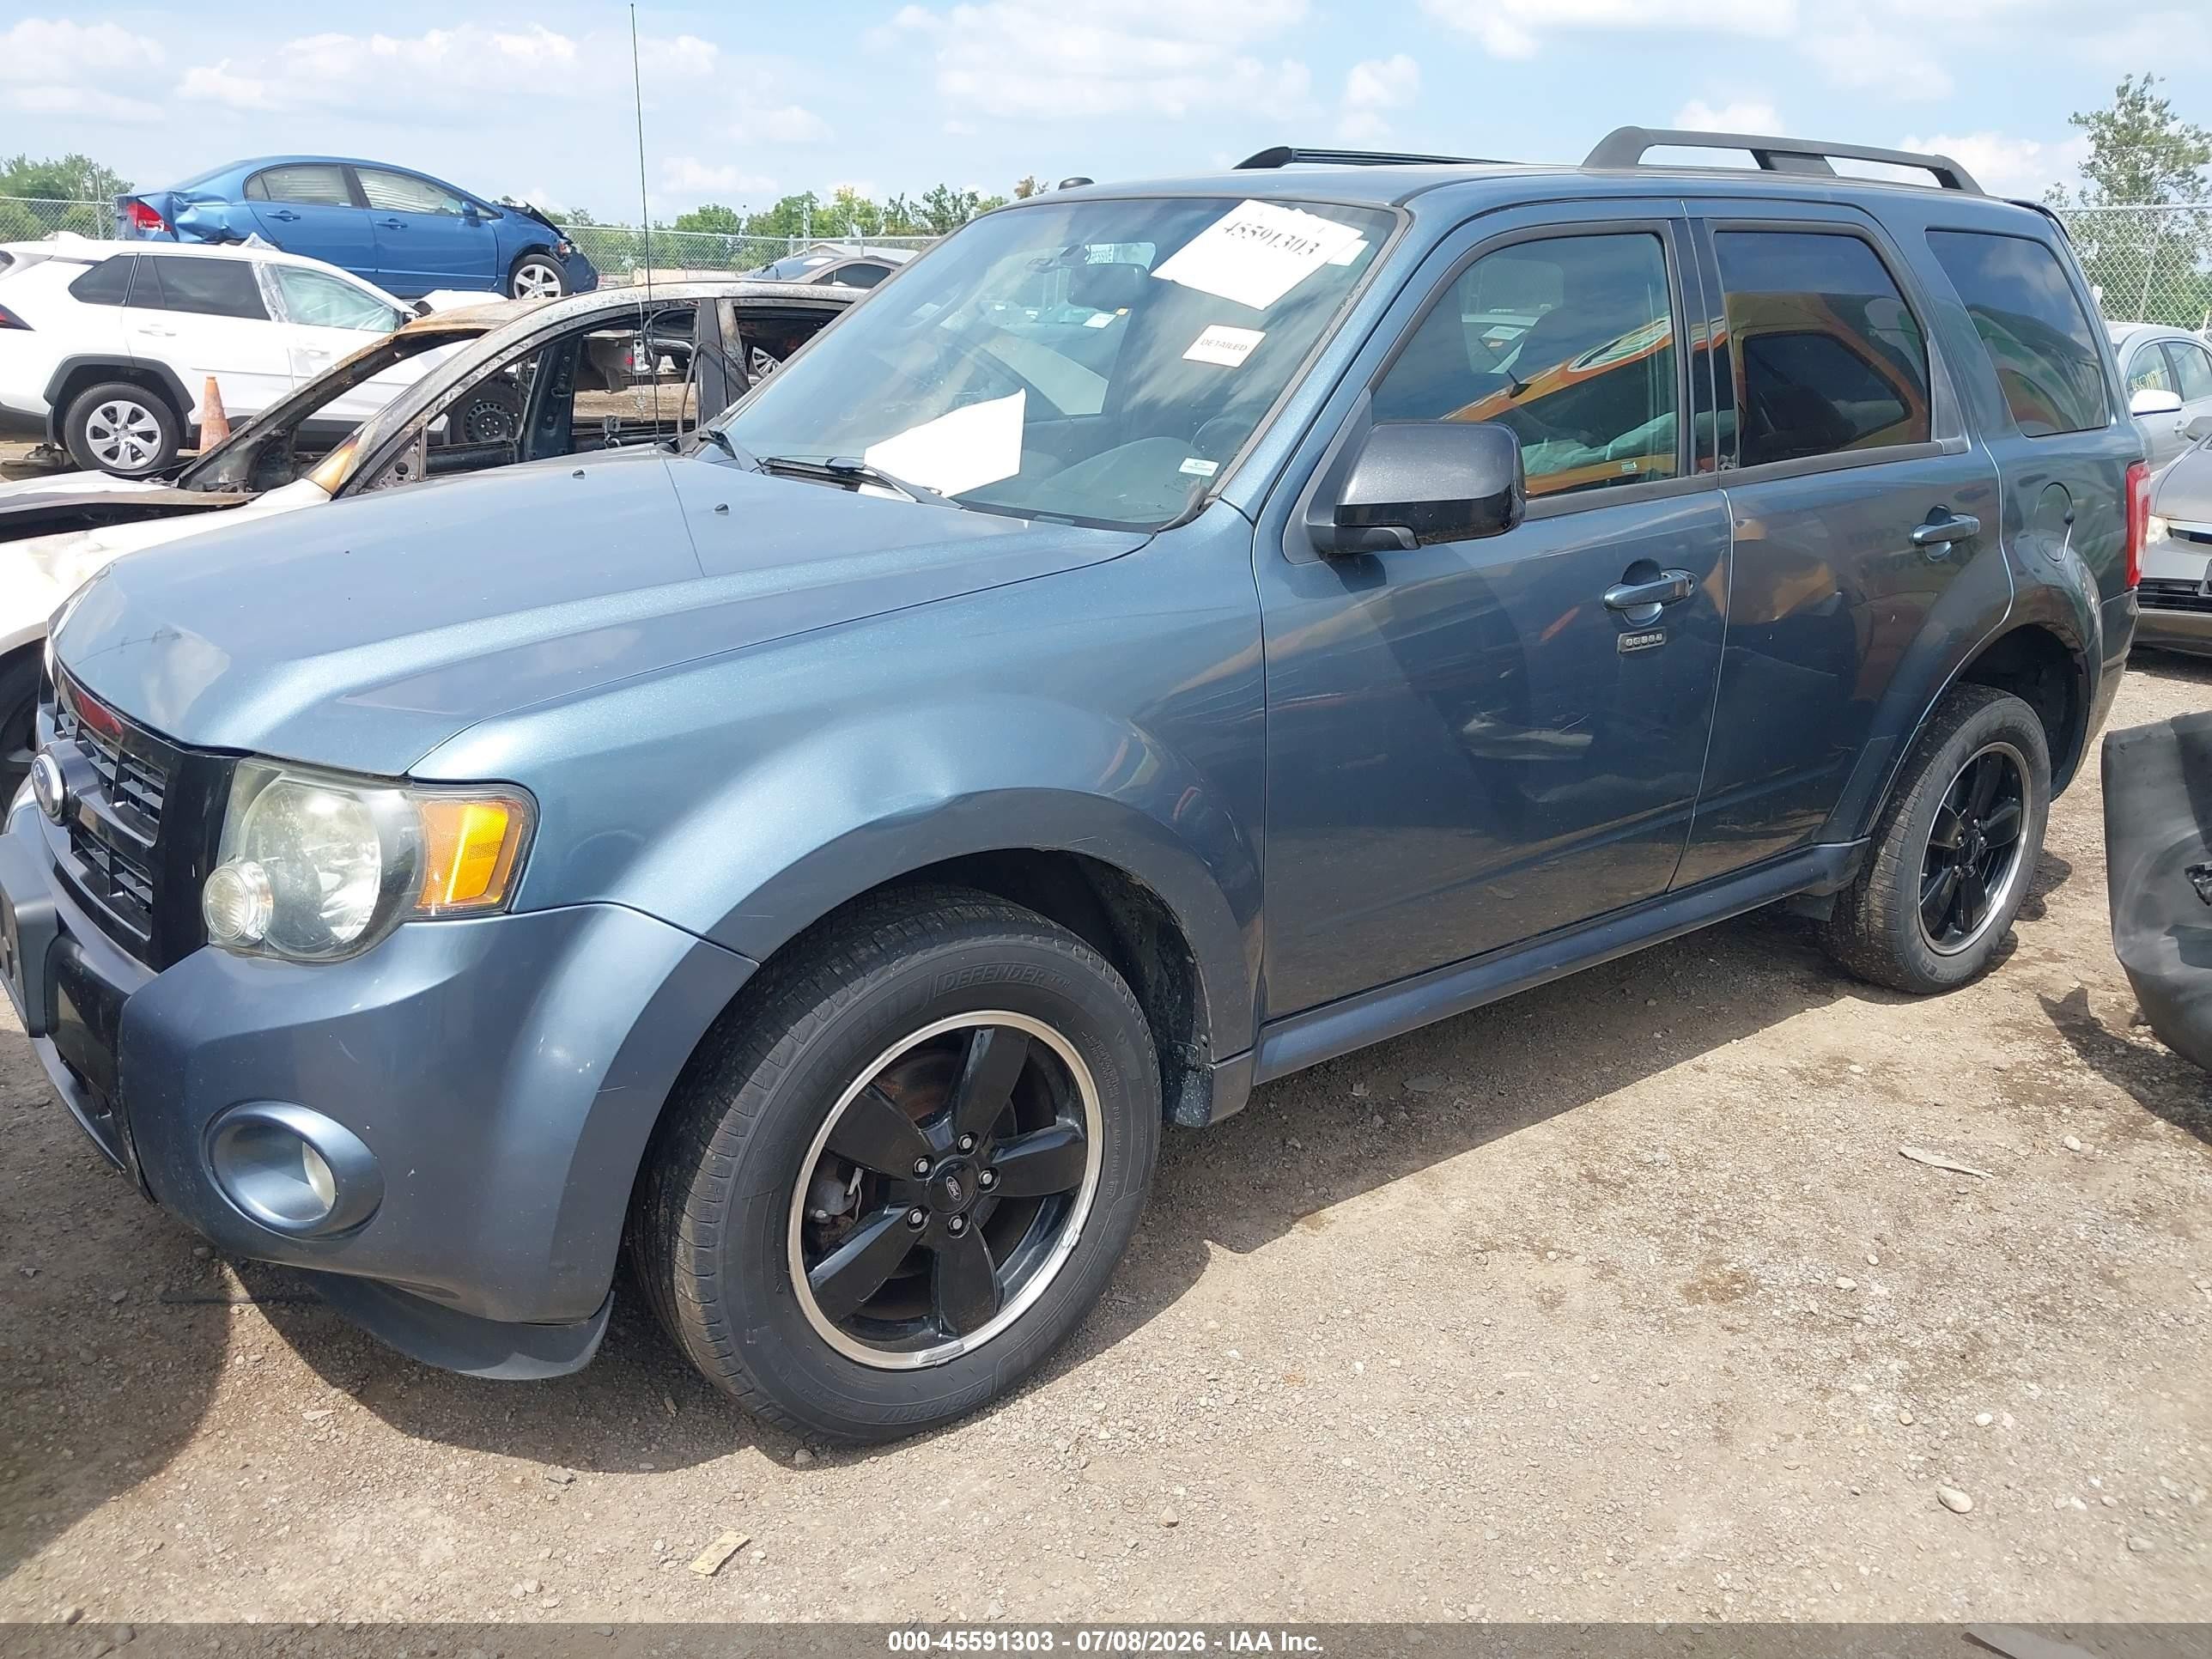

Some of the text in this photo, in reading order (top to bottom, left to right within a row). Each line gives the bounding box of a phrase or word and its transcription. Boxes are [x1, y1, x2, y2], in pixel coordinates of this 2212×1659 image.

[1224, 222, 1322, 256] 45591303
[1200, 338, 1248, 351] DETAILED
[943, 963, 1045, 991] DEFENDER
[947, 1179, 961, 1198] Ford
